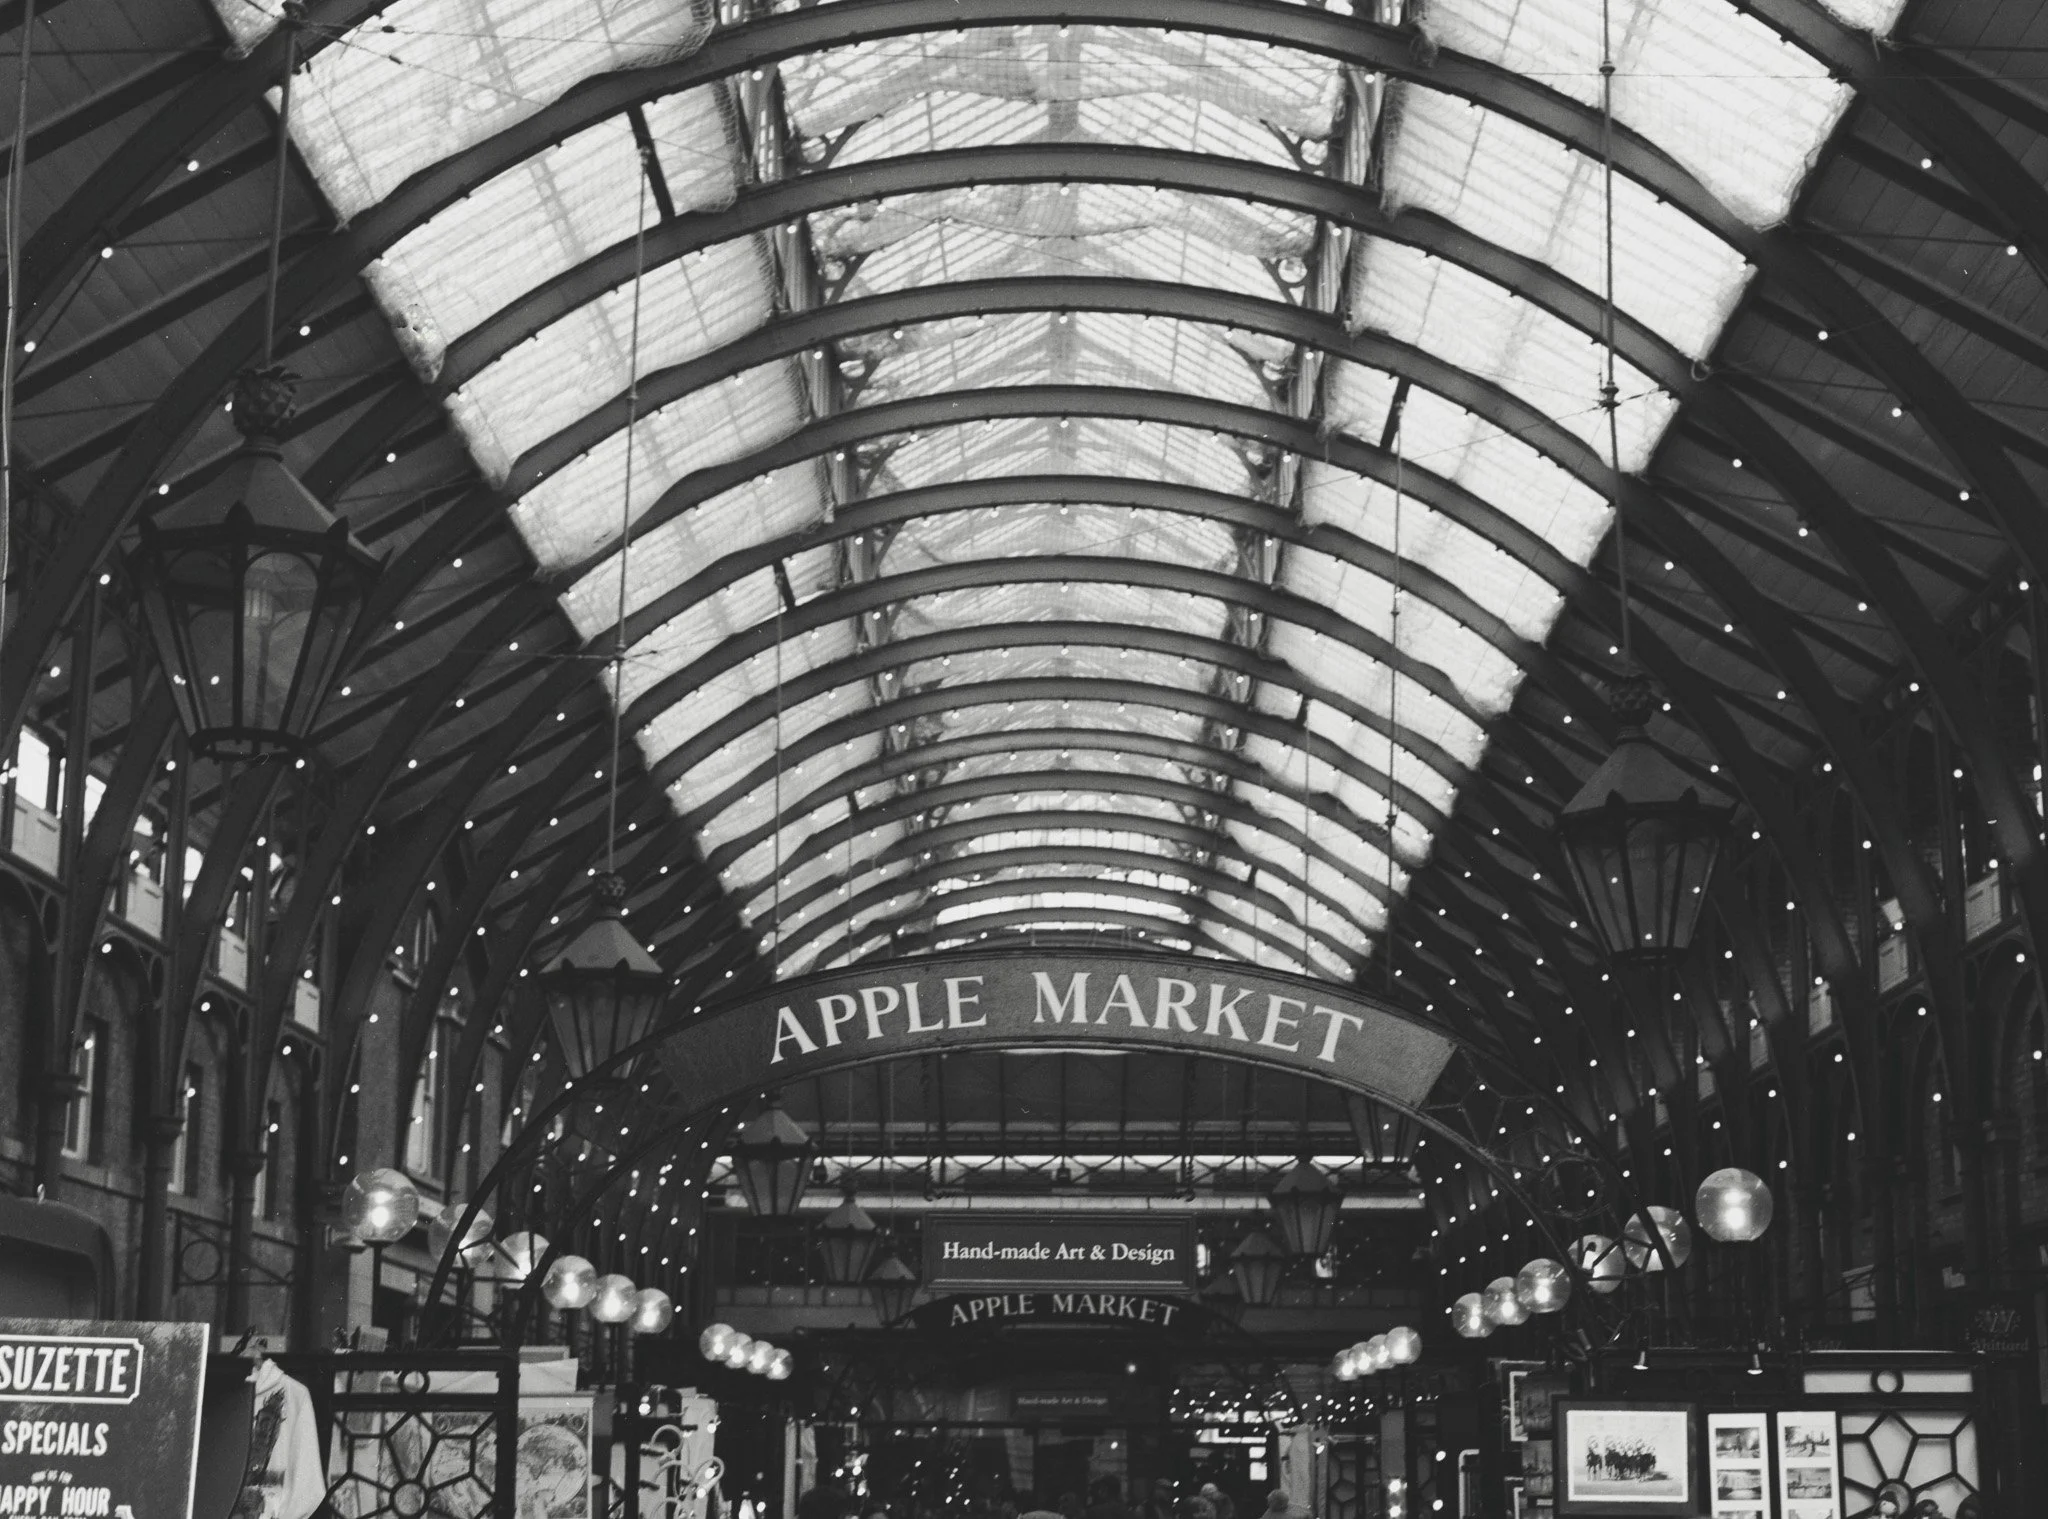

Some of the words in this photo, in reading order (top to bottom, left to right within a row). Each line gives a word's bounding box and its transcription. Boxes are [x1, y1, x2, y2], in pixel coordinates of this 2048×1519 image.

[769, 974, 988, 1064] APPLE
[1031, 972, 1365, 1063] MARKET
[942, 1241, 1051, 1261] Hand-made
[1054, 1242, 1086, 1261] Art
[1089, 1244, 1106, 1261] &
[1111, 1242, 1175, 1266] Design
[950, 1293, 1036, 1328] APPLE
[1052, 1294, 1180, 1327] MARKET
[0, 1345, 131, 1393] SUZETTE
[1, 1420, 109, 1457] SPECIALS
[0, 1485, 52, 1515] APPY
[60, 1486, 111, 1517] HOUR
